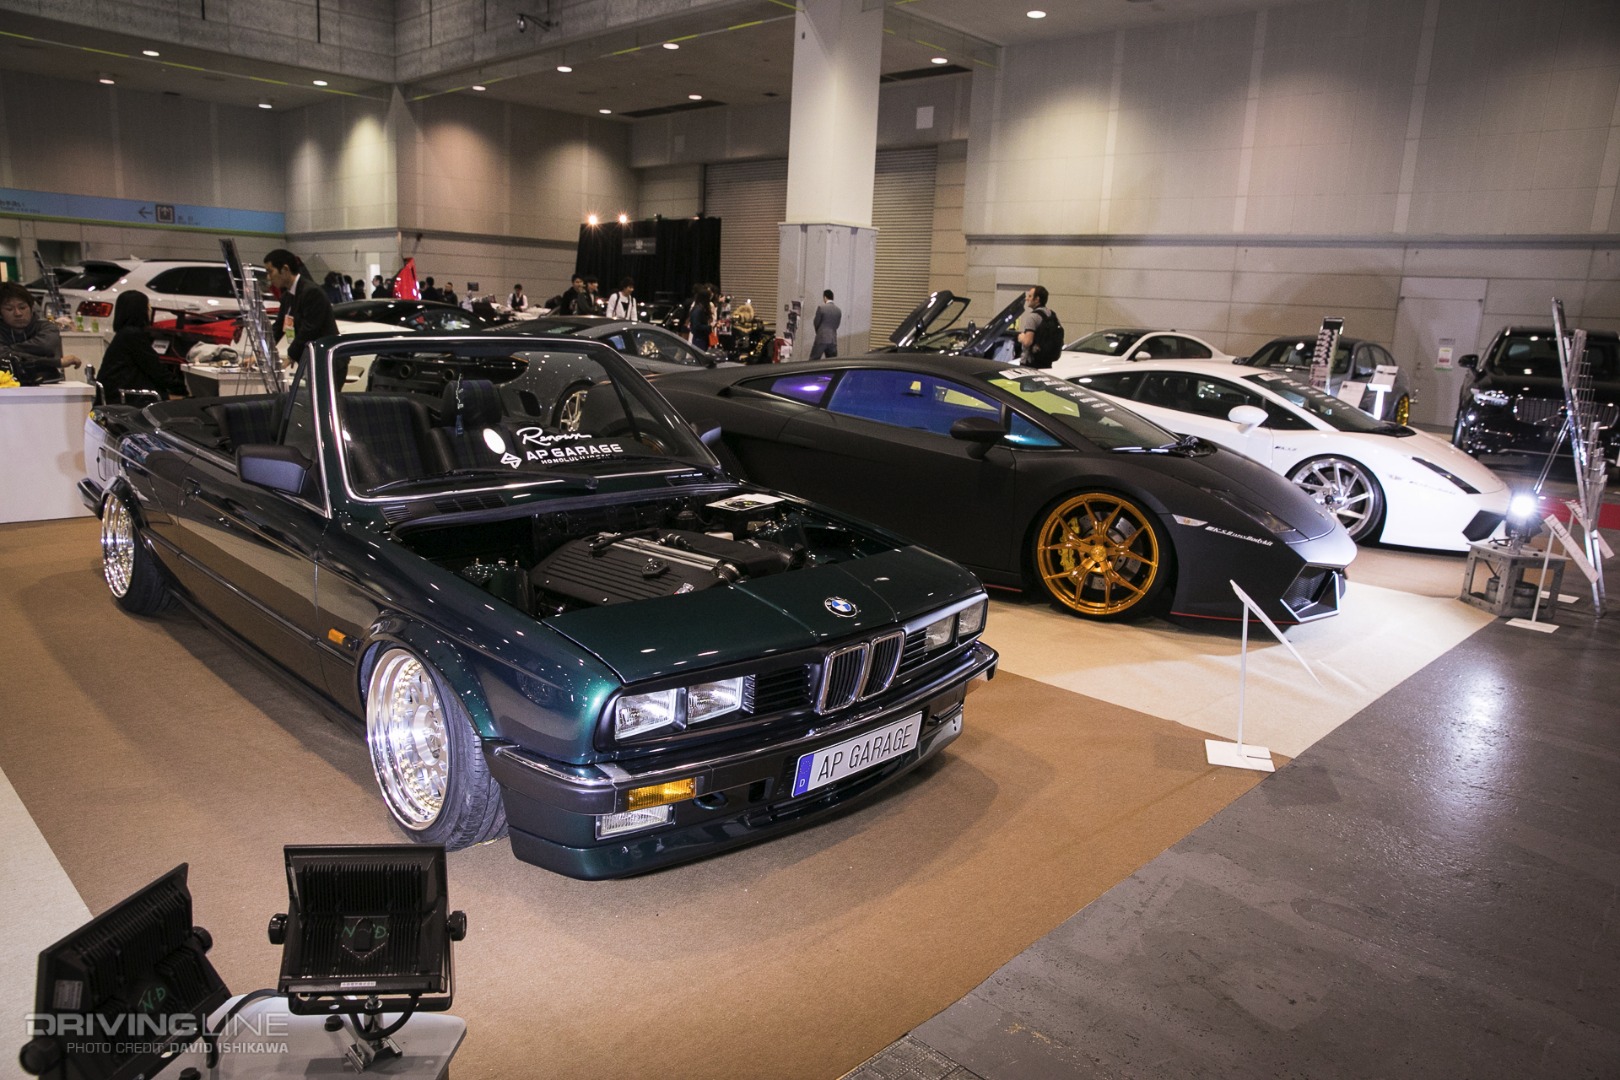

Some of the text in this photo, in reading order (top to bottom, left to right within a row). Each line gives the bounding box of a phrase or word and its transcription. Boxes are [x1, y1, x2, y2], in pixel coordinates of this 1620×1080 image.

[526, 449, 548, 461] AP
[551, 443, 624, 458] GARAGE
[817, 723, 913, 781] AP GARAGE
[799, 778, 806, 788] D
